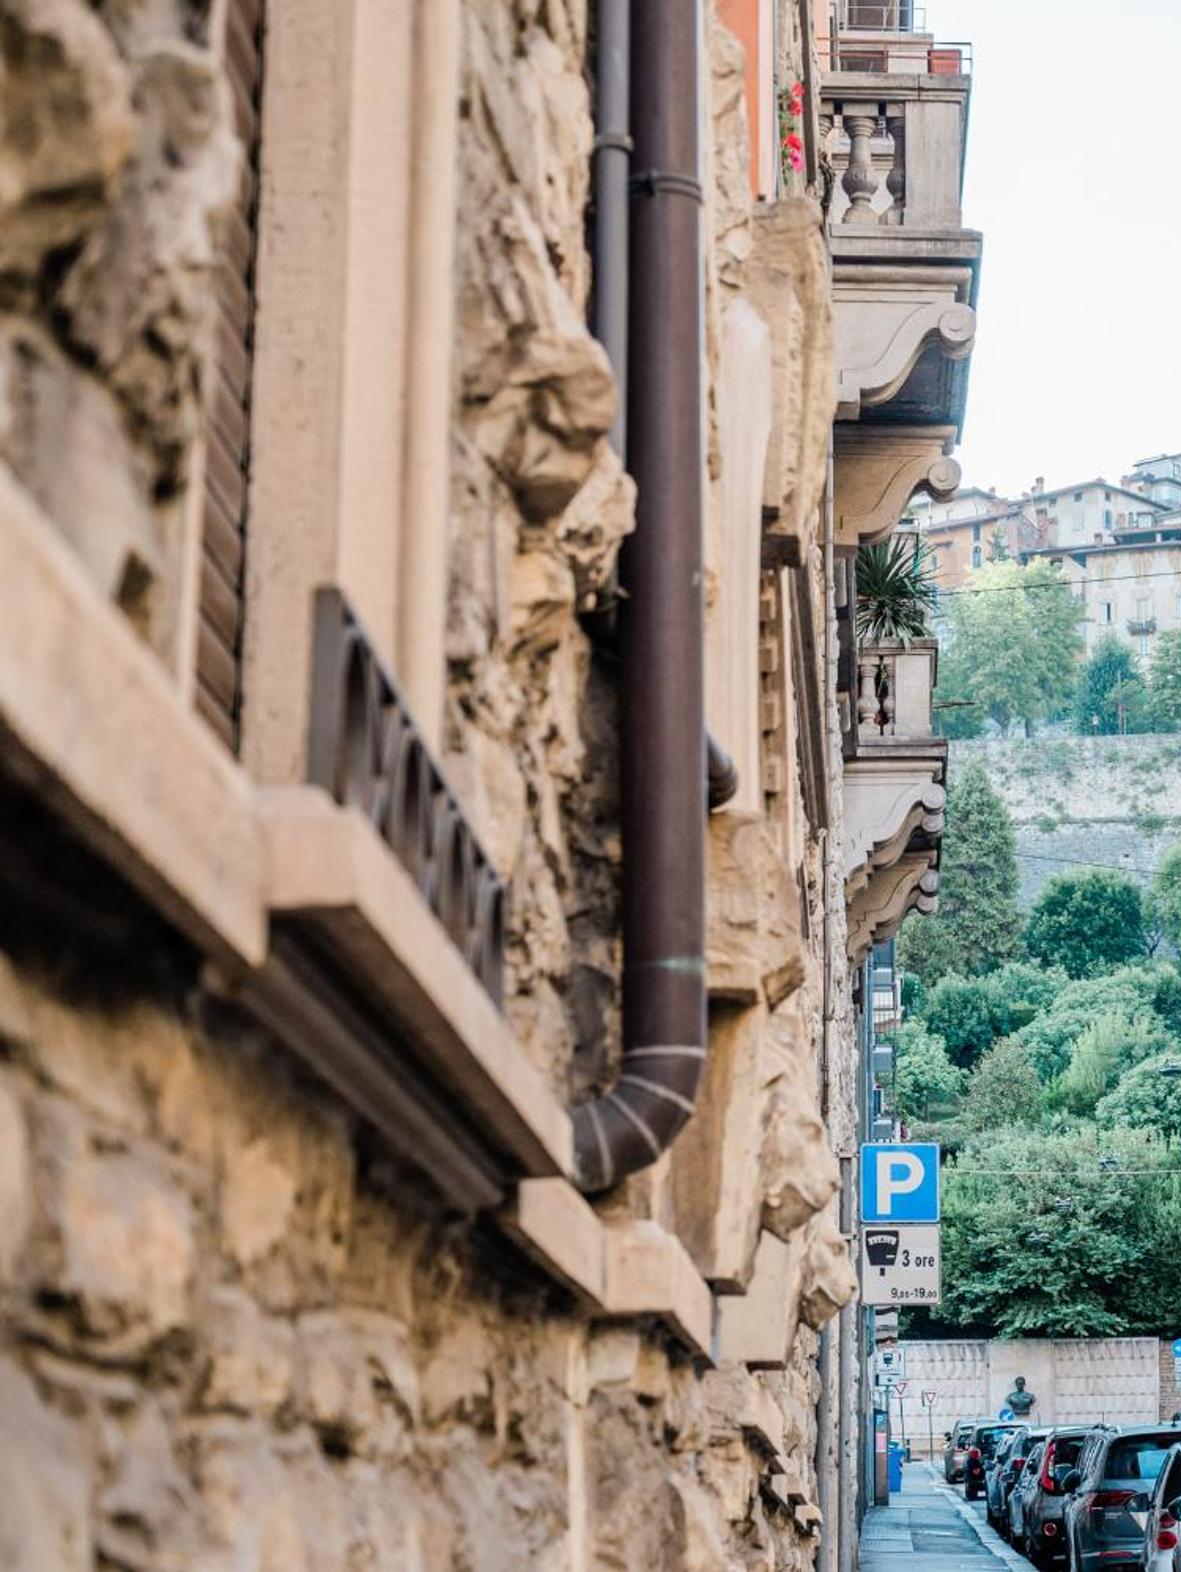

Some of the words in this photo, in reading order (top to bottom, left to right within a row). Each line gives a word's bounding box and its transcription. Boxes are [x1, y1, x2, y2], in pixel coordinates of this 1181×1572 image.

[876, 1151, 925, 1215] P
[901, 1249, 910, 1267] 3
[914, 1256, 935, 1267] ore
